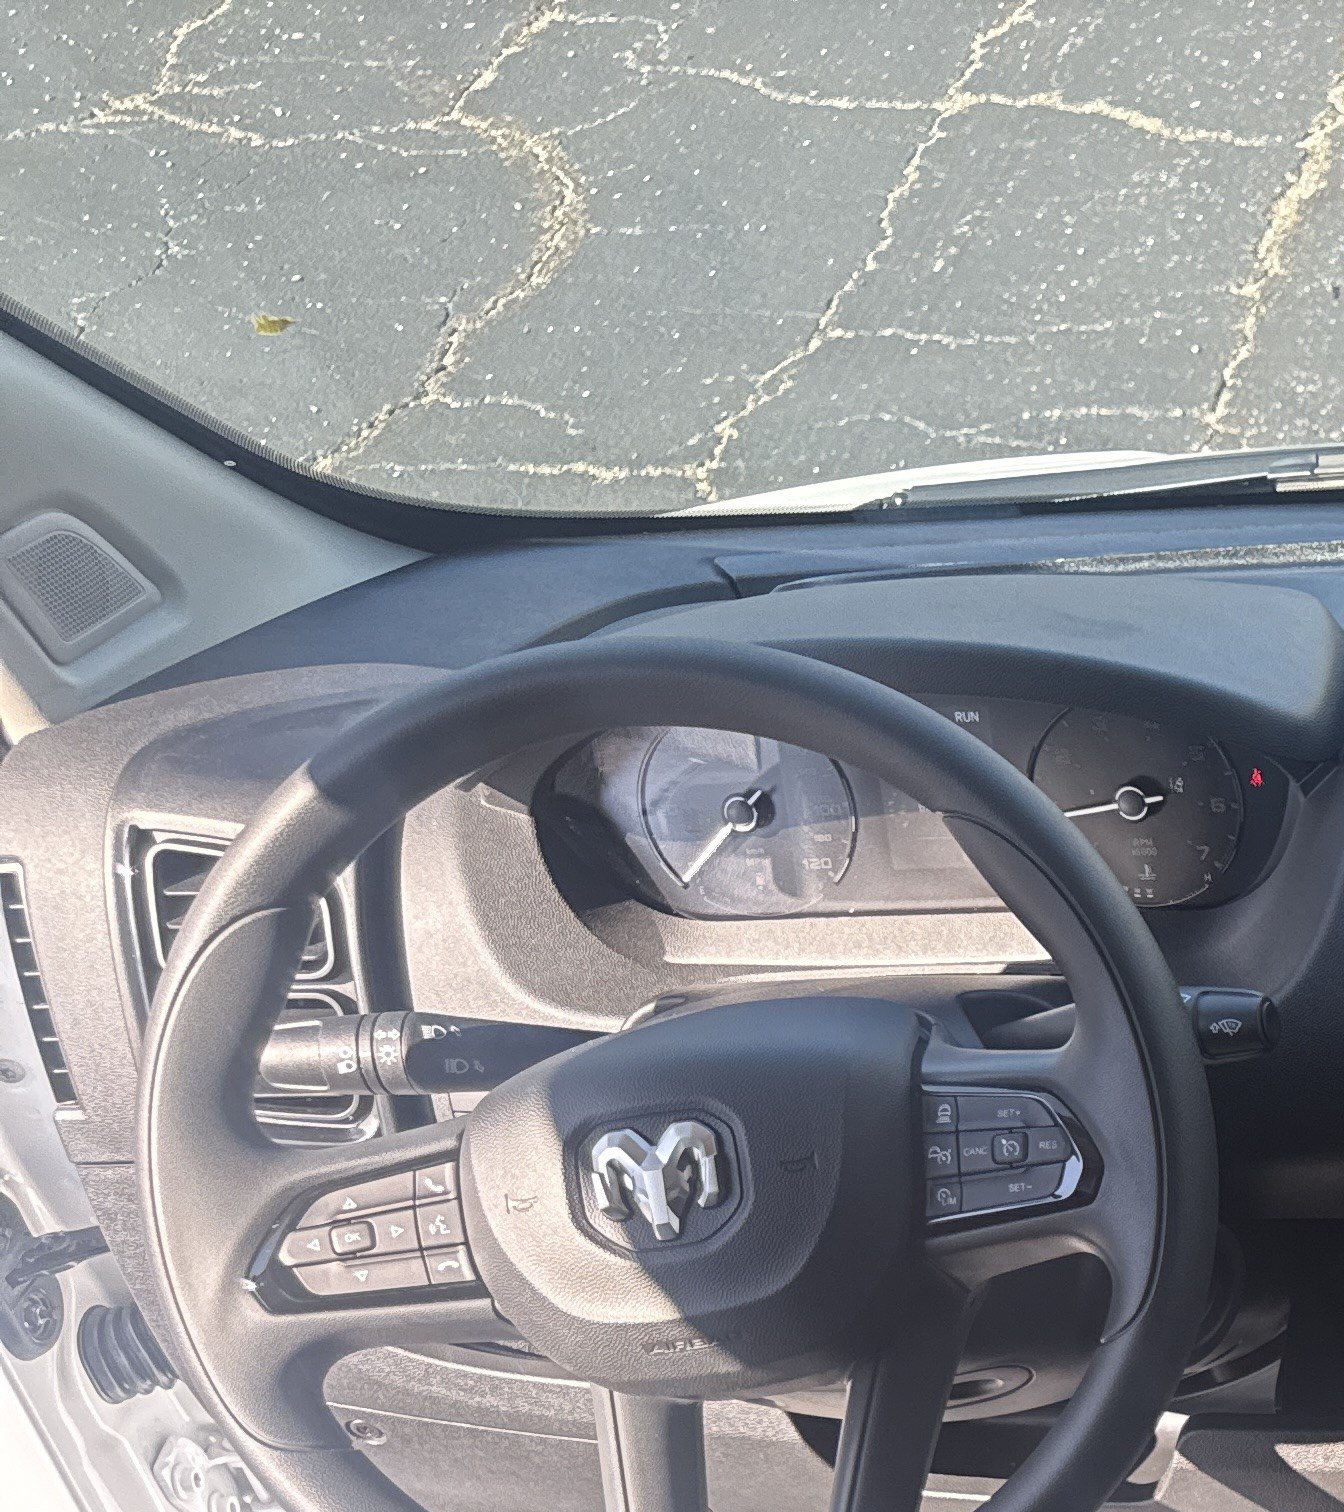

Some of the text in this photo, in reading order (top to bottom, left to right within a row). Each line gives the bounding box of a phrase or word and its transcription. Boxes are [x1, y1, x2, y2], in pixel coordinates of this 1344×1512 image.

[954, 711, 980, 723] RUN
[802, 858, 832, 869] 120
[1038, 1140, 1058, 1150] RES
[963, 1147, 988, 1157] CANC
[344, 1233, 362, 1243] OK
